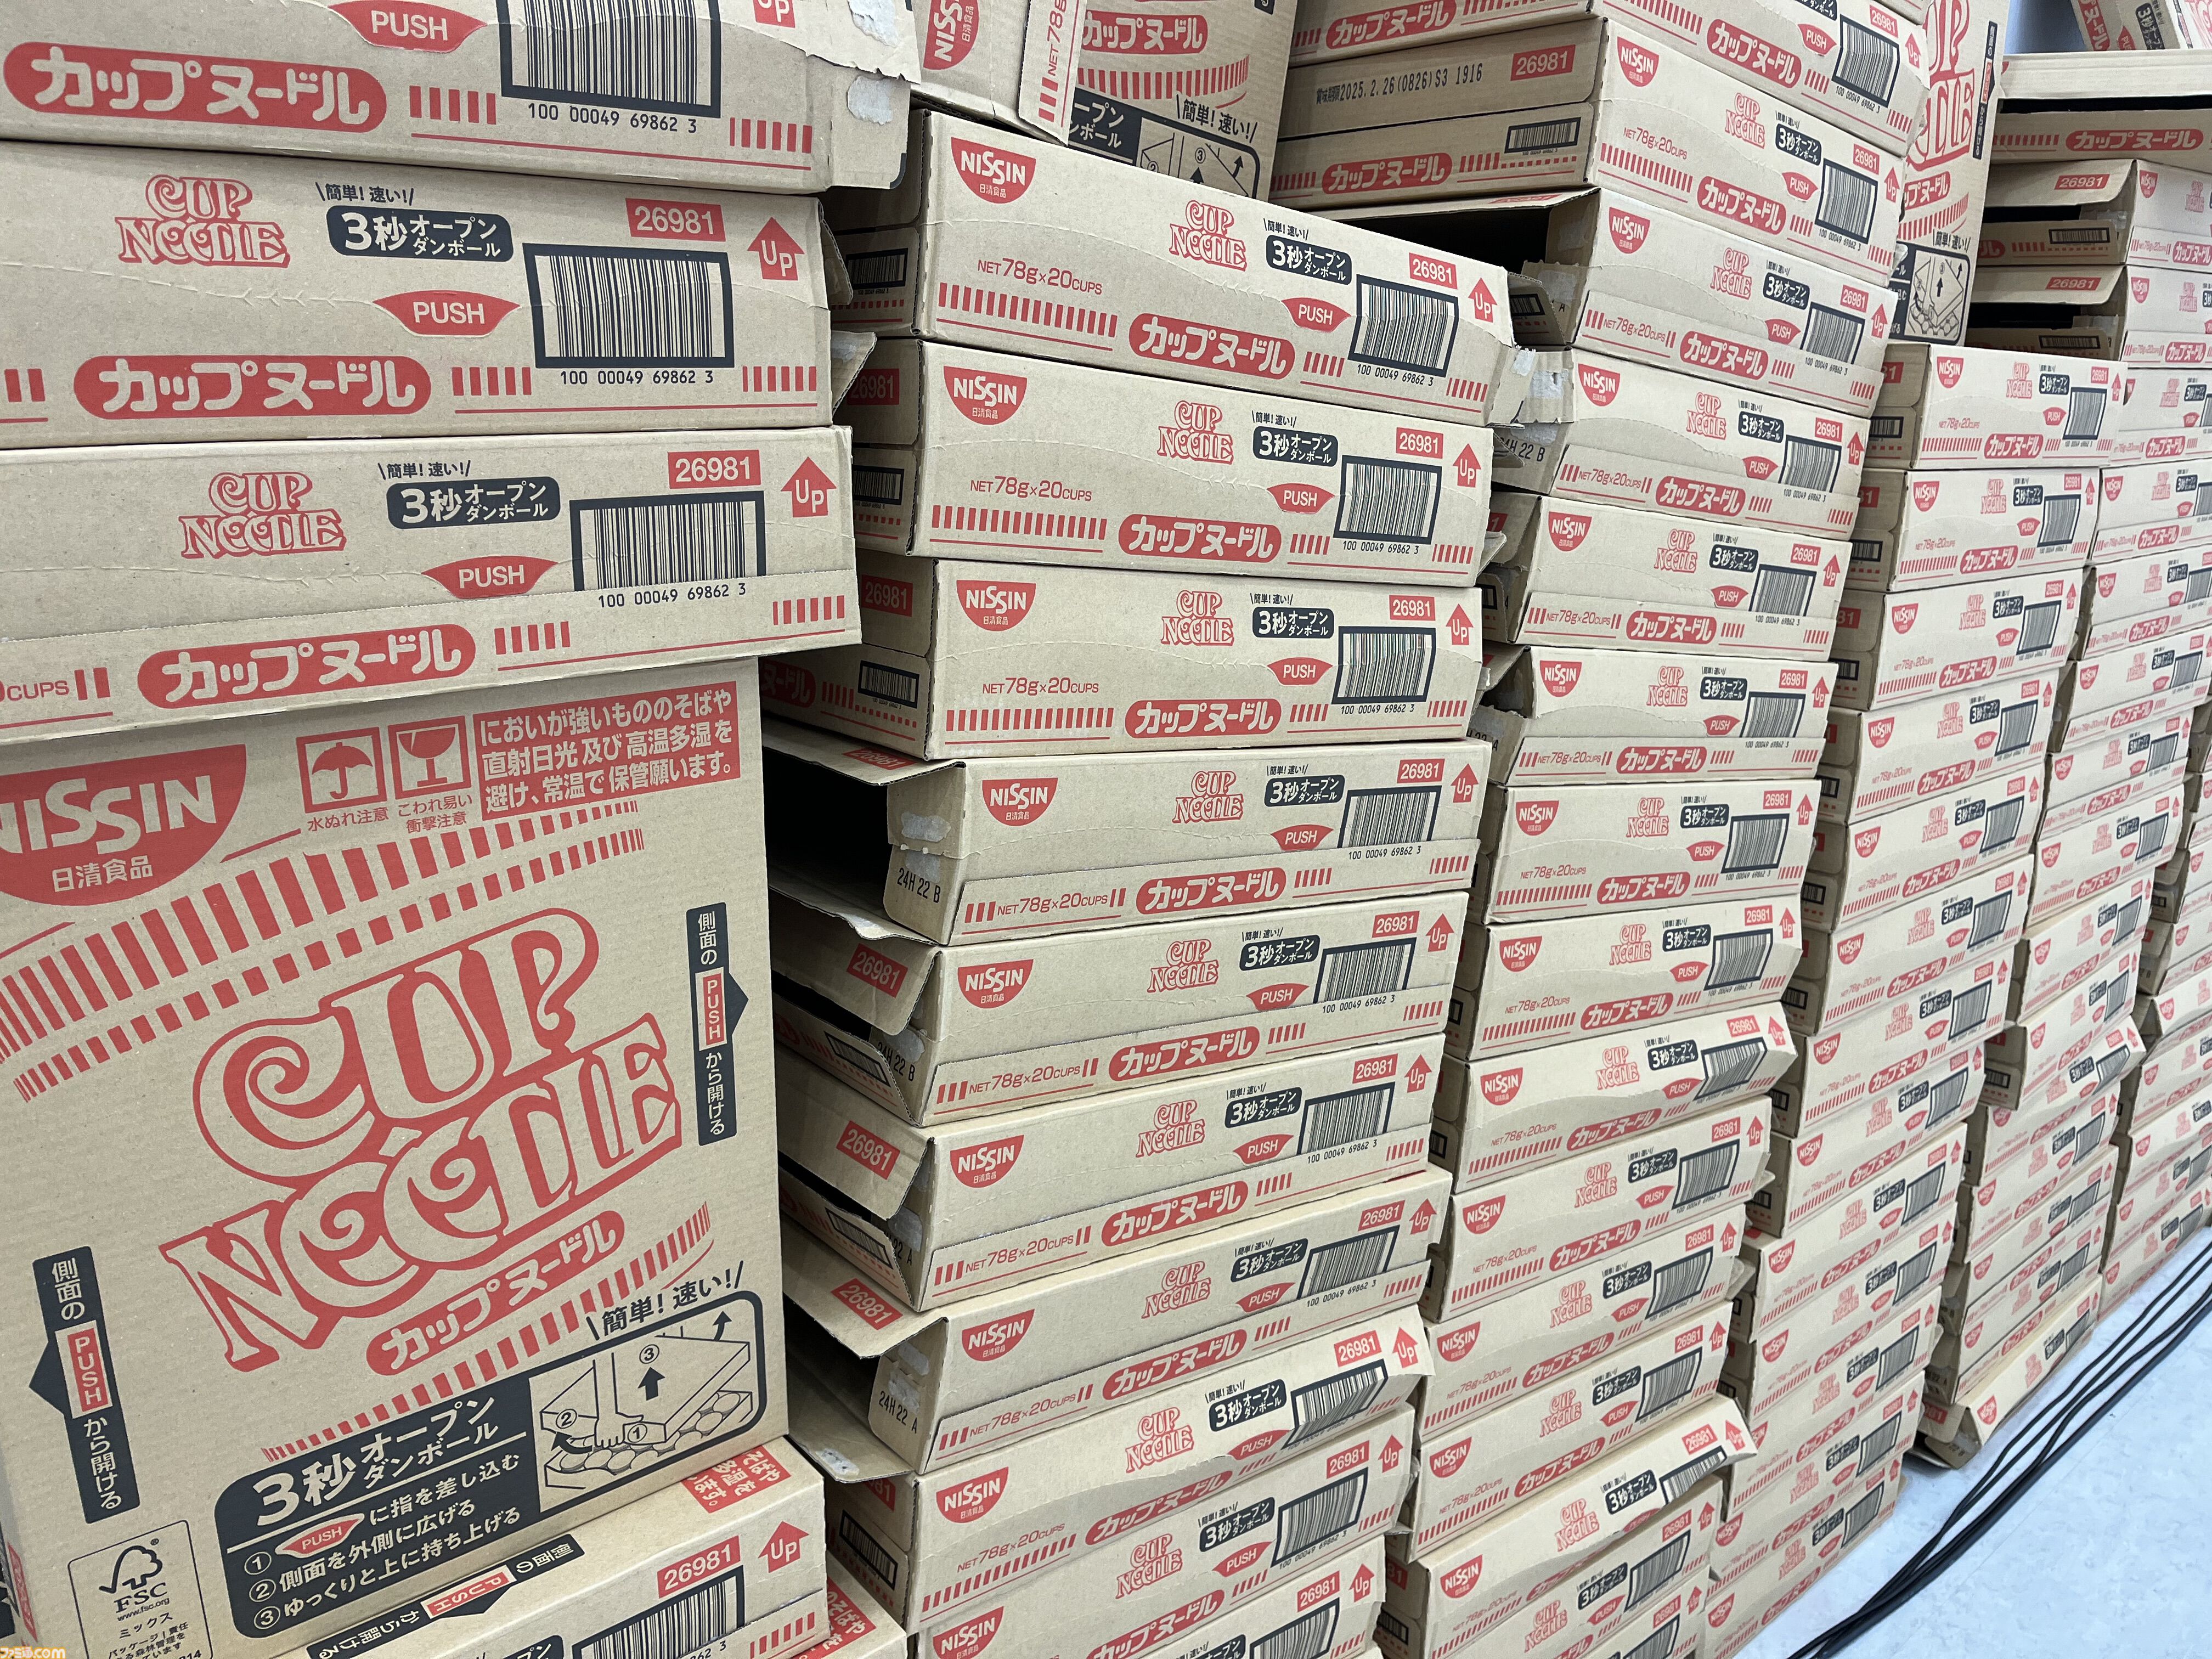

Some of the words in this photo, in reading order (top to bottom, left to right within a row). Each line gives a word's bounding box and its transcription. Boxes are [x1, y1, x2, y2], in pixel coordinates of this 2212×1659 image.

[371, 10, 448, 41] PUSH
[1871, 9, 1895, 33] 26981
[1806, 30, 1827, 50] PUSH
[1516, 50, 1568, 76] 26981
[1621, 46, 1654, 75] NISSIN
[32, 46, 370, 124] カップヌードル
[1456, 64, 1483, 84] 1916
[528, 103, 559, 121] 100
[569, 106, 619, 127] 00049
[630, 114, 678, 132] 69862
[688, 119, 697, 134] 3
[961, 149, 1026, 187] NISSIN
[1855, 148, 1878, 171] 26981
[1790, 177, 1809, 195] PUSH
[2059, 176, 2104, 188] 26981
[146, 174, 253, 220] CUP
[634, 206, 716, 235] 26981
[1186, 200, 1234, 236] CUP
[761, 239, 793, 272] UP
[1413, 258, 1454, 284] 26981
[2050, 279, 2096, 289] 26981
[1475, 291, 1492, 319] UP
[1843, 289, 1866, 309] 26981
[413, 301, 485, 325] PUSH
[1299, 304, 1333, 325] PUSH
[1139, 315, 1286, 374] カップヌードル
[1772, 324, 1792, 340] PUSH
[560, 370, 588, 385] 100
[598, 369, 644, 385] 00049
[653, 369, 696, 385] 69862
[705, 370, 714, 384] 3
[1357, 363, 1371, 376] 100
[1375, 366, 1398, 381] 00049
[1402, 371, 1425, 386] 69862
[1429, 376, 1434, 387] 3
[1939, 360, 1962, 376] NISSIN
[99, 358, 416, 413] カップヌードル
[953, 376, 1017, 407] NISSIN
[1583, 373, 1616, 394] NISSIN
[972, 407, 998, 419] 日清食品
[1818, 421, 1842, 438] 26981
[1399, 433, 1438, 454] 26981
[675, 456, 752, 483] 26981
[1749, 461, 1769, 475] PUSH
[208, 472, 313, 514] CUP
[795, 478, 825, 513] UP
[1283, 490, 1317, 507] PUSH
[1915, 484, 1937, 501] NISSIN
[1128, 516, 1273, 558] カップヌードル
[458, 565, 525, 589] PUSH
[865, 581, 908, 610] 26981
[1392, 599, 1431, 617] 26981
[1894, 607, 1916, 624] NISSIN
[162, 629, 461, 704] カップヌードル
[1283, 665, 1316, 679] PUSH
[1544, 665, 1576, 683] NISSIN
[1782, 673, 1805, 686] 26981
[1134, 702, 1274, 734] カップヌードル
[1710, 720, 1730, 732] PUSH
[1401, 763, 1440, 781] 26981
[398, 793, 473, 817] こわれ易い
[990, 782, 1048, 810] NISSIN
[307, 806, 389, 833] 水ぬれ注意
[406, 811, 467, 834] 衝撃注意
[1285, 831, 1317, 844] PUSH
[1857, 832, 1878, 849] NISSIN
[52, 855, 154, 893] 日清食品
[917, 878, 930, 899] 22
[933, 884, 941, 904] B
[697, 911, 718, 965] 側面の
[1503, 941, 1537, 961] NISSIN
[852, 951, 901, 990] 26981
[707, 980, 722, 1040] PUSH
[1260, 989, 1293, 1005] PUSH
[1730, 1019, 1757, 1034] 26981
[193, 907, 600, 1192] CUP
[1118, 1031, 1254, 1076] カップヌードル
[1815, 1040, 1838, 1058] NISSIN
[1356, 1059, 1394, 1079] 26981
[1153, 1099, 1198, 1125] CUP
[841, 1128, 892, 1171] 26981
[957, 1144, 1015, 1174] NISSIN
[1362, 1208, 1401, 1228] 26981
[1466, 1203, 1502, 1224] NISSIN
[382, 1220, 616, 1370] カップヌードル
[838, 1284, 892, 1324] 26981
[52, 1257, 86, 1321] 側面の
[75, 1336, 103, 1406] PUSH
[968, 1317, 1026, 1350] NISSIN
[1338, 1338, 1376, 1362] 26981
[1108, 1332, 1239, 1397] カップヌードル
[896, 1404, 909, 1423] 22
[911, 1416, 918, 1435] A
[1329, 1447, 1367, 1474] 26981
[944, 1477, 1001, 1513] NISSIN
[279, 1499, 475, 1592] 側面を外側に広げる
[302, 1526, 343, 1551] PUSH
[770, 1541, 797, 1561] UP
[663, 1543, 732, 1589] 26981
[1226, 1549, 1257, 1572] PUSH
[1444, 1563, 1480, 1590] NISSIN
[114, 1582, 167, 1613] FSC
[433, 1576, 503, 1612] PUSH
[117, 1598, 170, 1621] www.fsc.org
[119, 1612, 173, 1639] ミックス
[940, 1617, 996, 1652] NISSIN
